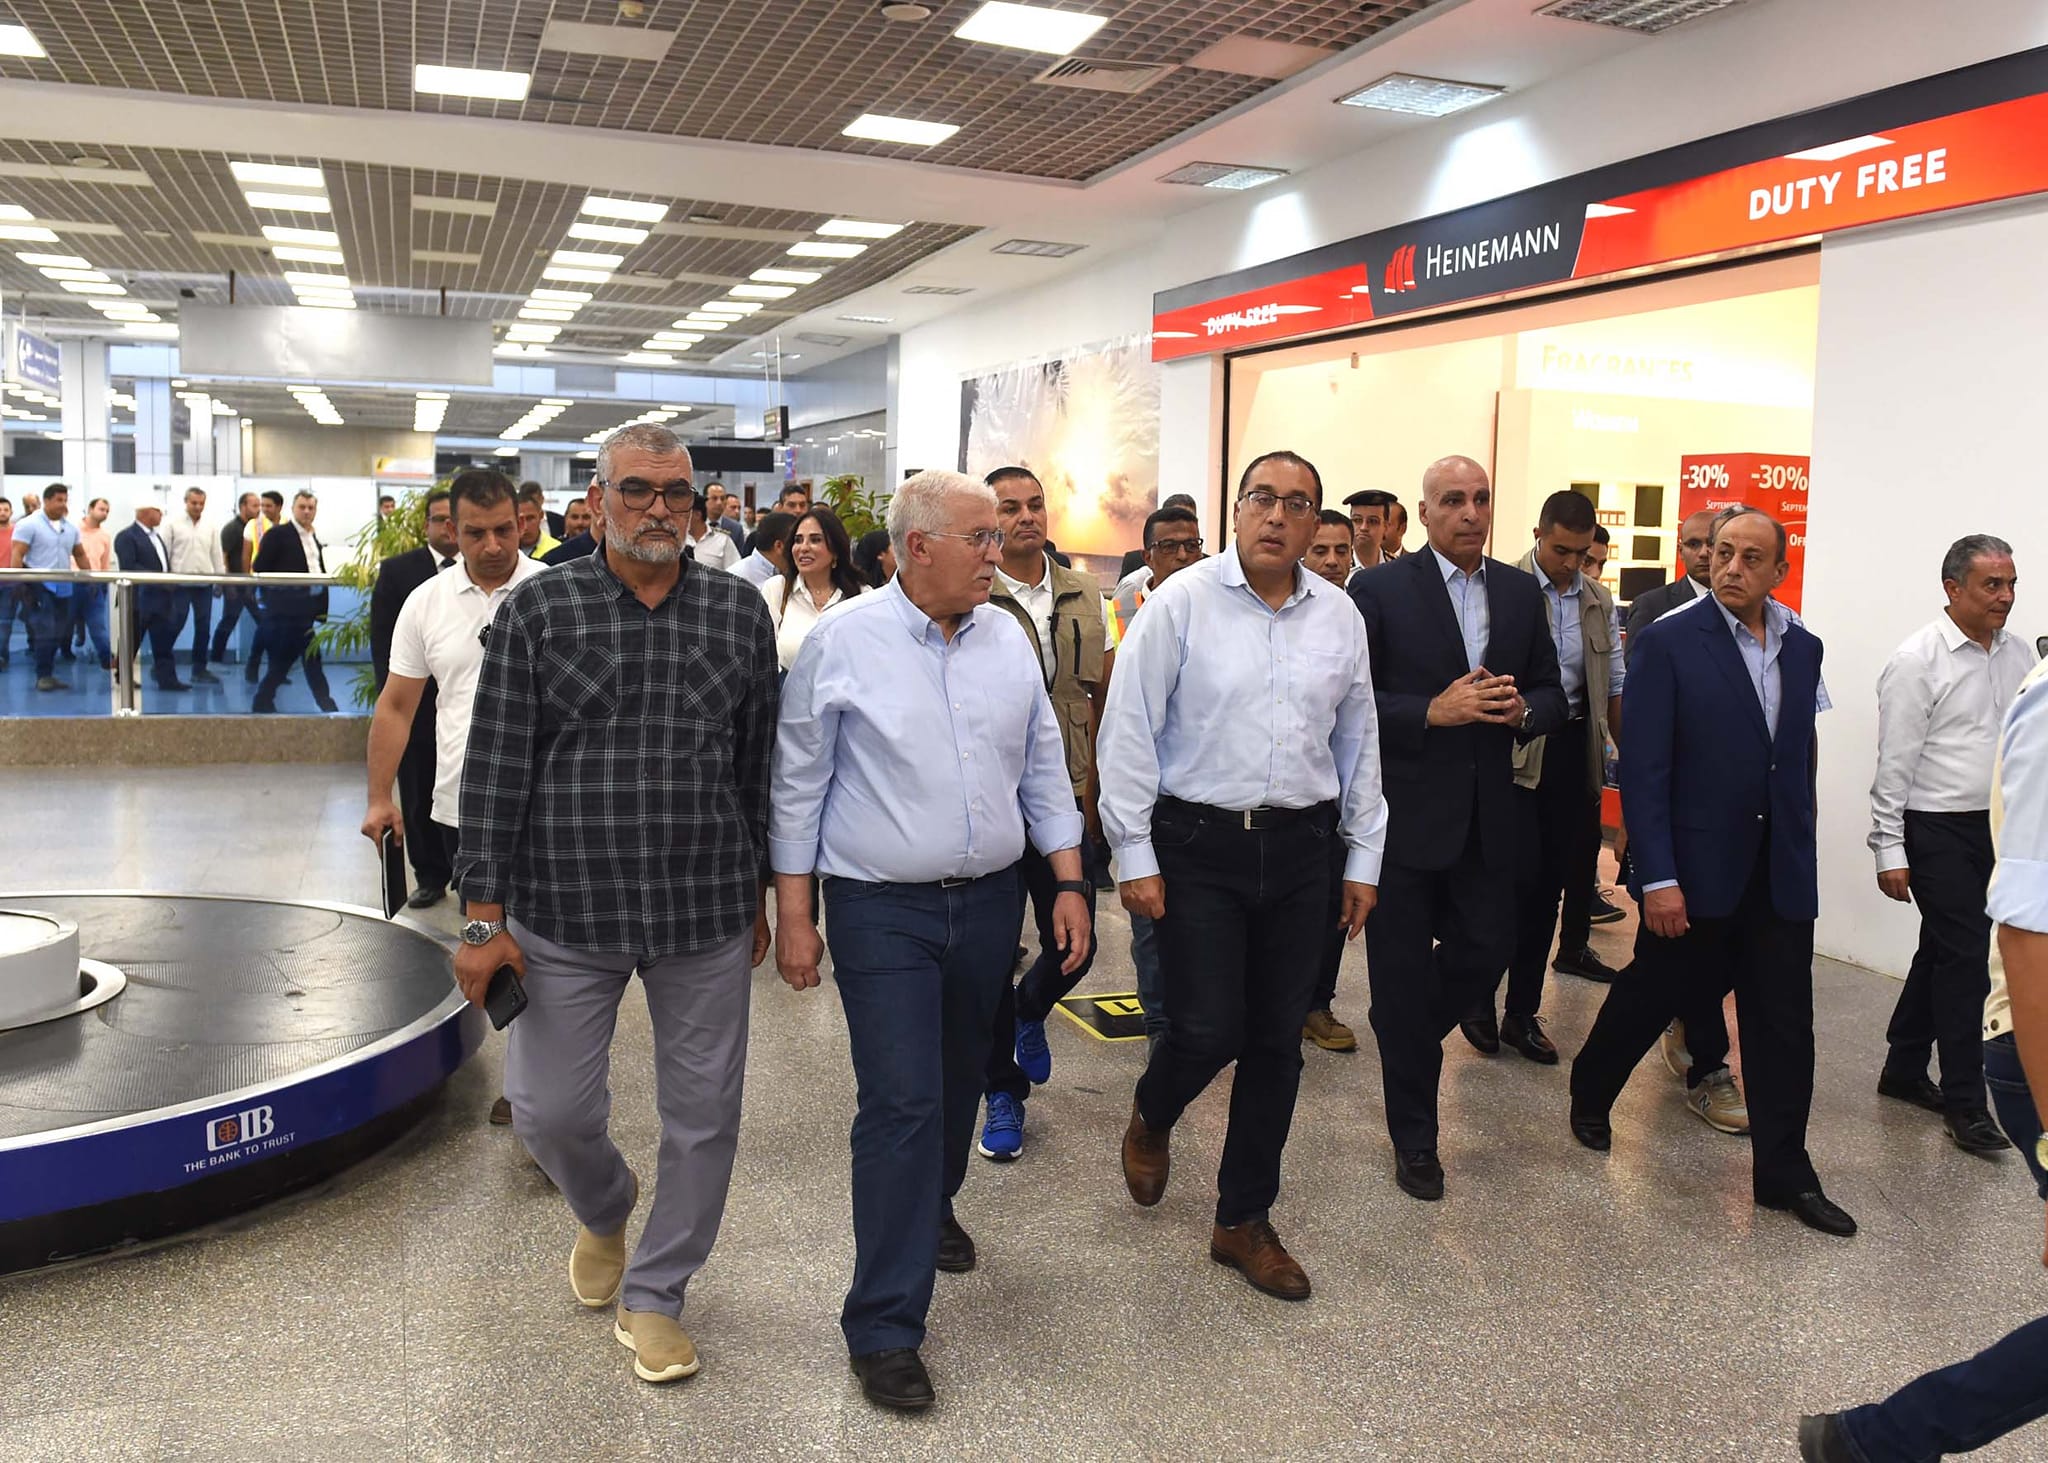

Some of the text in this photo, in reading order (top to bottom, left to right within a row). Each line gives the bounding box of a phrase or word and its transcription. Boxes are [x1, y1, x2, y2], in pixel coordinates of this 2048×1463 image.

[1749, 148, 1947, 220] DUTY FREE
[1426, 222, 1560, 280] HEINEMANN
[1207, 303, 1278, 336] DUTY FREE
[1541, 344, 1694, 383] FRAGRANCES
[1682, 464, 1729, 489] -30%
[1751, 464, 1809, 491] -30%
[206, 1105, 274, 1151] CIB
[184, 1132, 295, 1173] THE BANK TO TRUST
